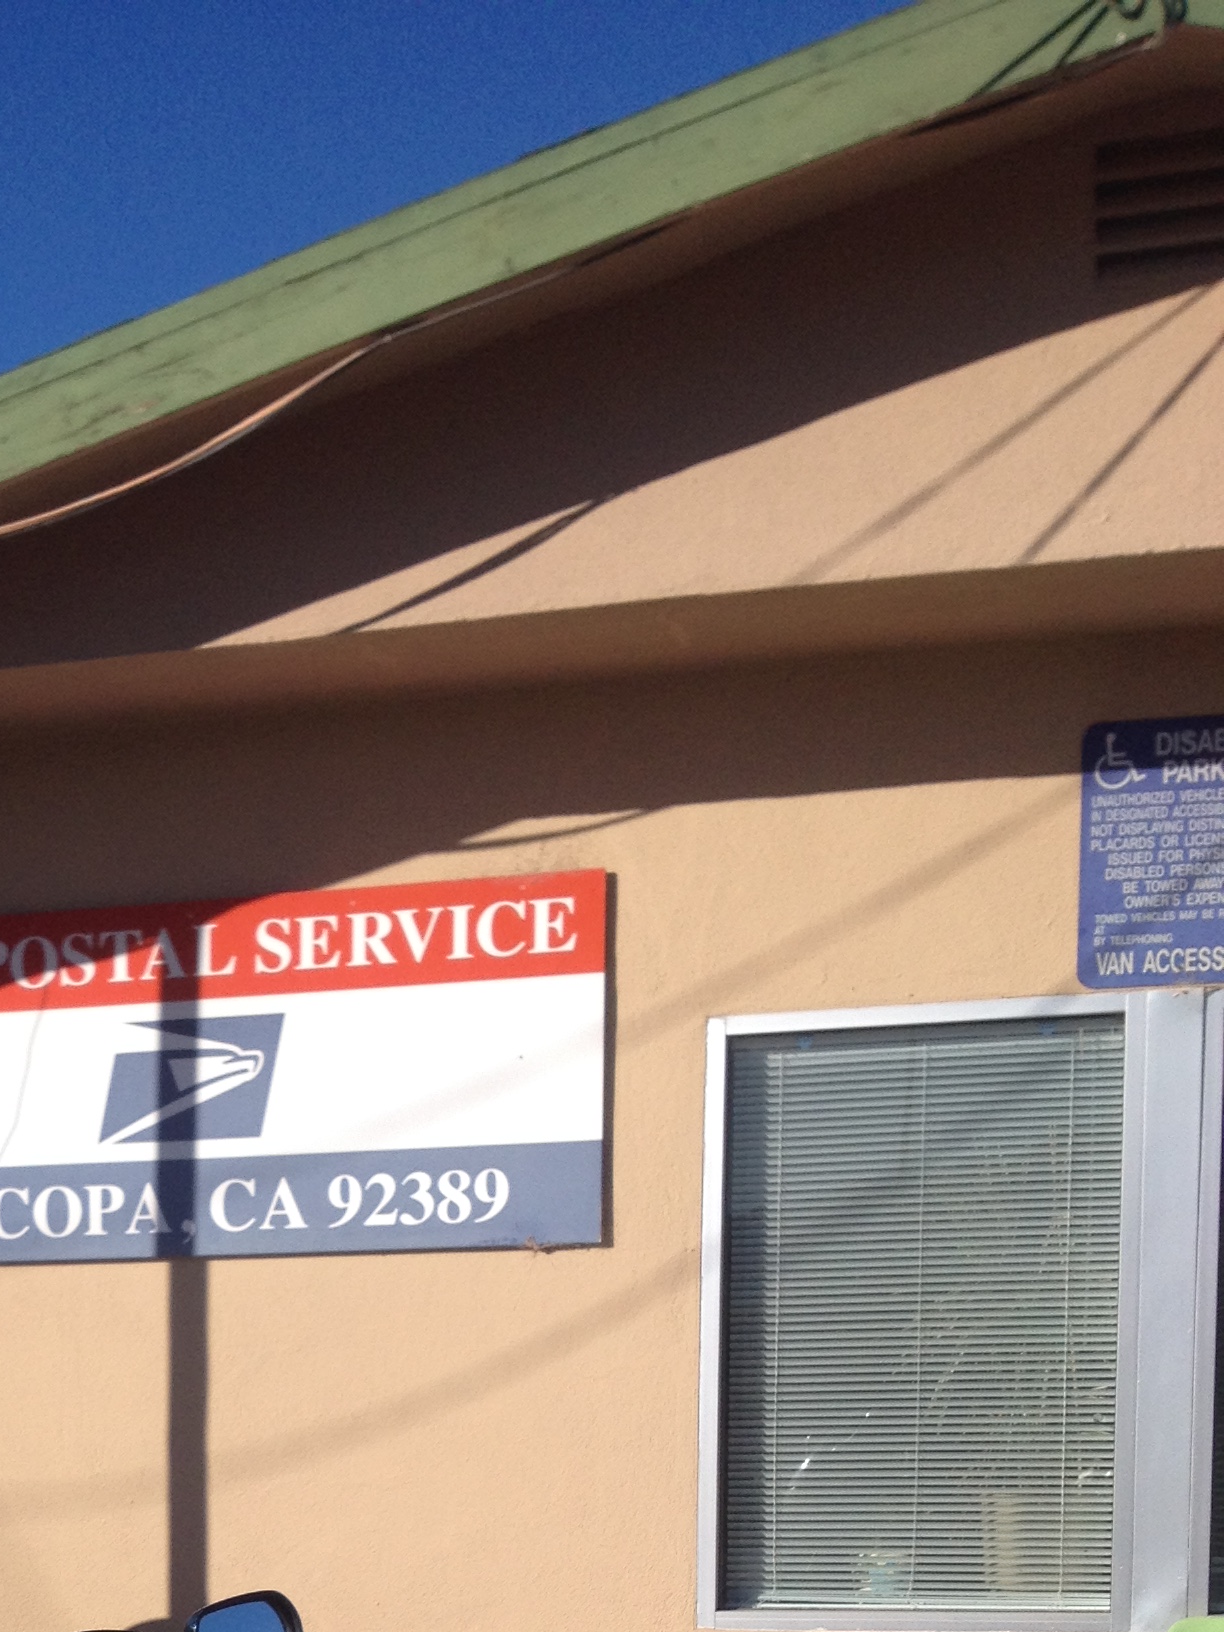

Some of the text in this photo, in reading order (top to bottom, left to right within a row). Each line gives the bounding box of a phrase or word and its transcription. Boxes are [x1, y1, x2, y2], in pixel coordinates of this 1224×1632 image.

[1091, 790, 1175, 808] UNAUTHORIZED
[1105, 806, 1169, 821] DESIGNATED
[1091, 823, 1114, 837] NOT
[1118, 820, 1184, 836] DISPLAYING
[1090, 836, 1156, 851] PLACARDS
[1161, 834, 1179, 848] OR
[1108, 851, 1153, 866] ISSUED
[1158, 848, 1184, 863] FOR
[1105, 865, 1165, 881] DISABLED
[1122, 881, 1139, 894] BE
[1145, 878, 1188, 893] TOWED
[1095, 913, 1128, 924] TOWED
[1131, 911, 1176, 923] VEHICLES
[1179, 910, 1198, 921] MAY
[253, 896, 578, 975] SERVICE
[1110, 932, 1173, 945] TELEPHONING
[1096, 951, 1134, 976] VAN
[210, 1176, 308, 1232] CA
[327, 1167, 511, 1229] 92389
